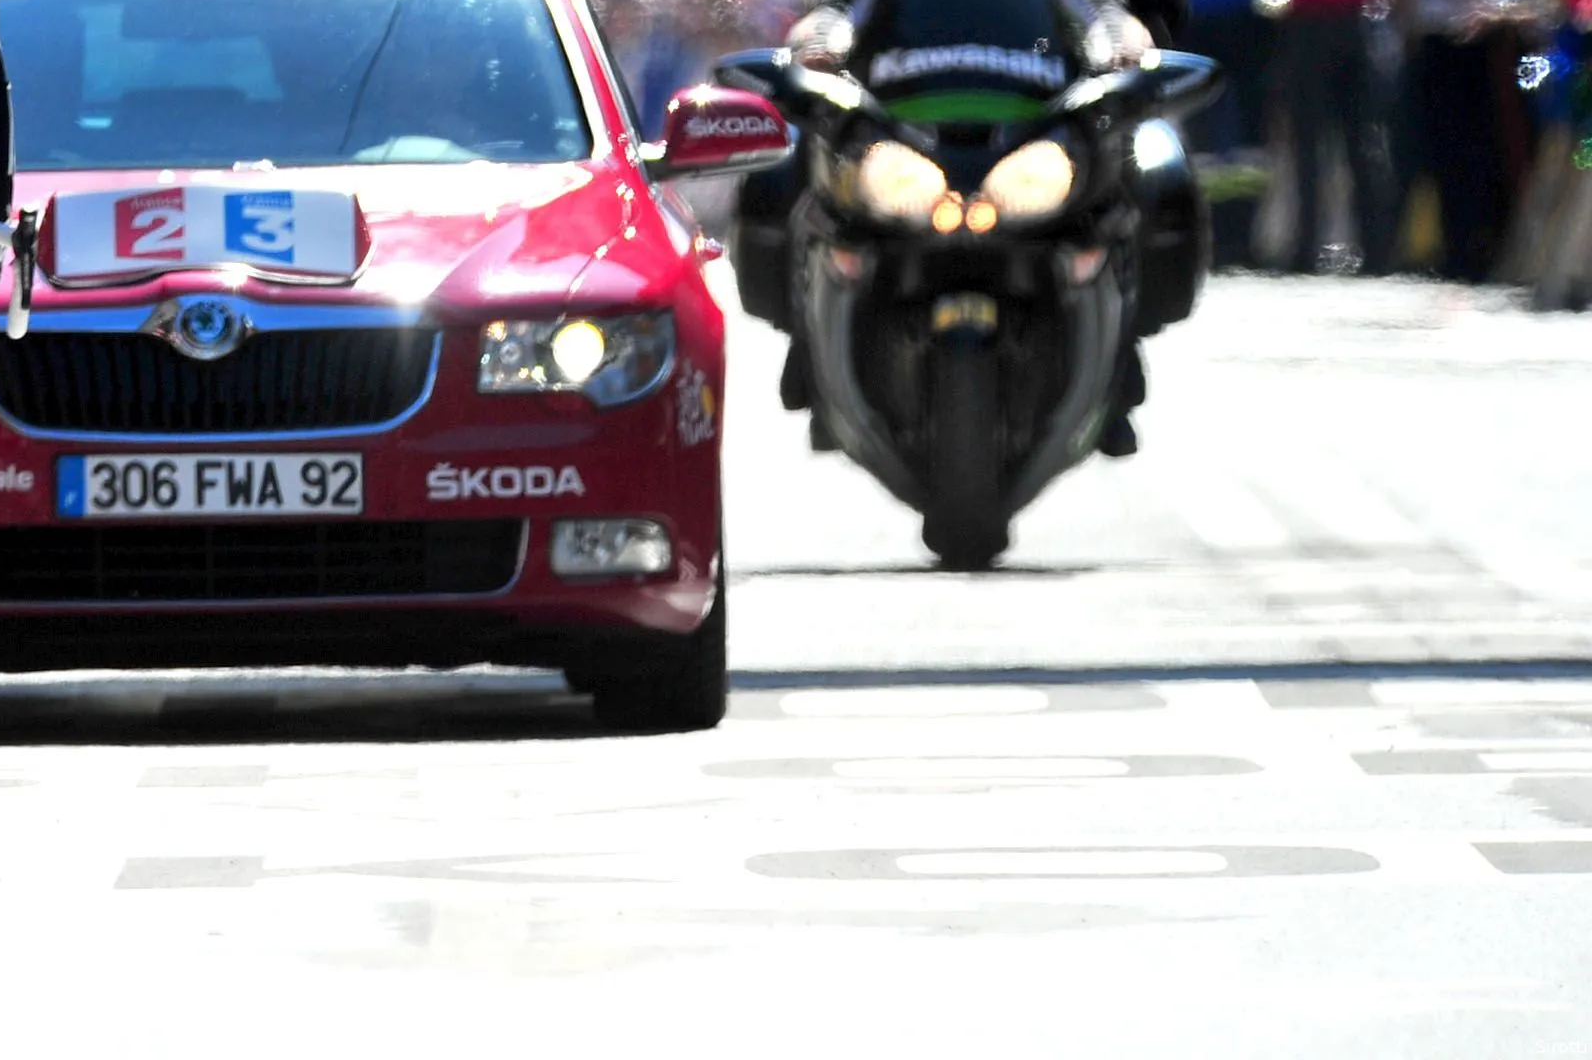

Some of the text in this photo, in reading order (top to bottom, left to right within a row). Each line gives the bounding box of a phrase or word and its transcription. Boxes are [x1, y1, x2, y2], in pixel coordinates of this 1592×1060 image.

[870, 42, 1066, 89] Kawasaki
[130, 207, 185, 255] 2
[241, 206, 294, 253] 3
[91, 459, 359, 509] 306 FWA 92
[426, 462, 587, 500] ŠKODA
